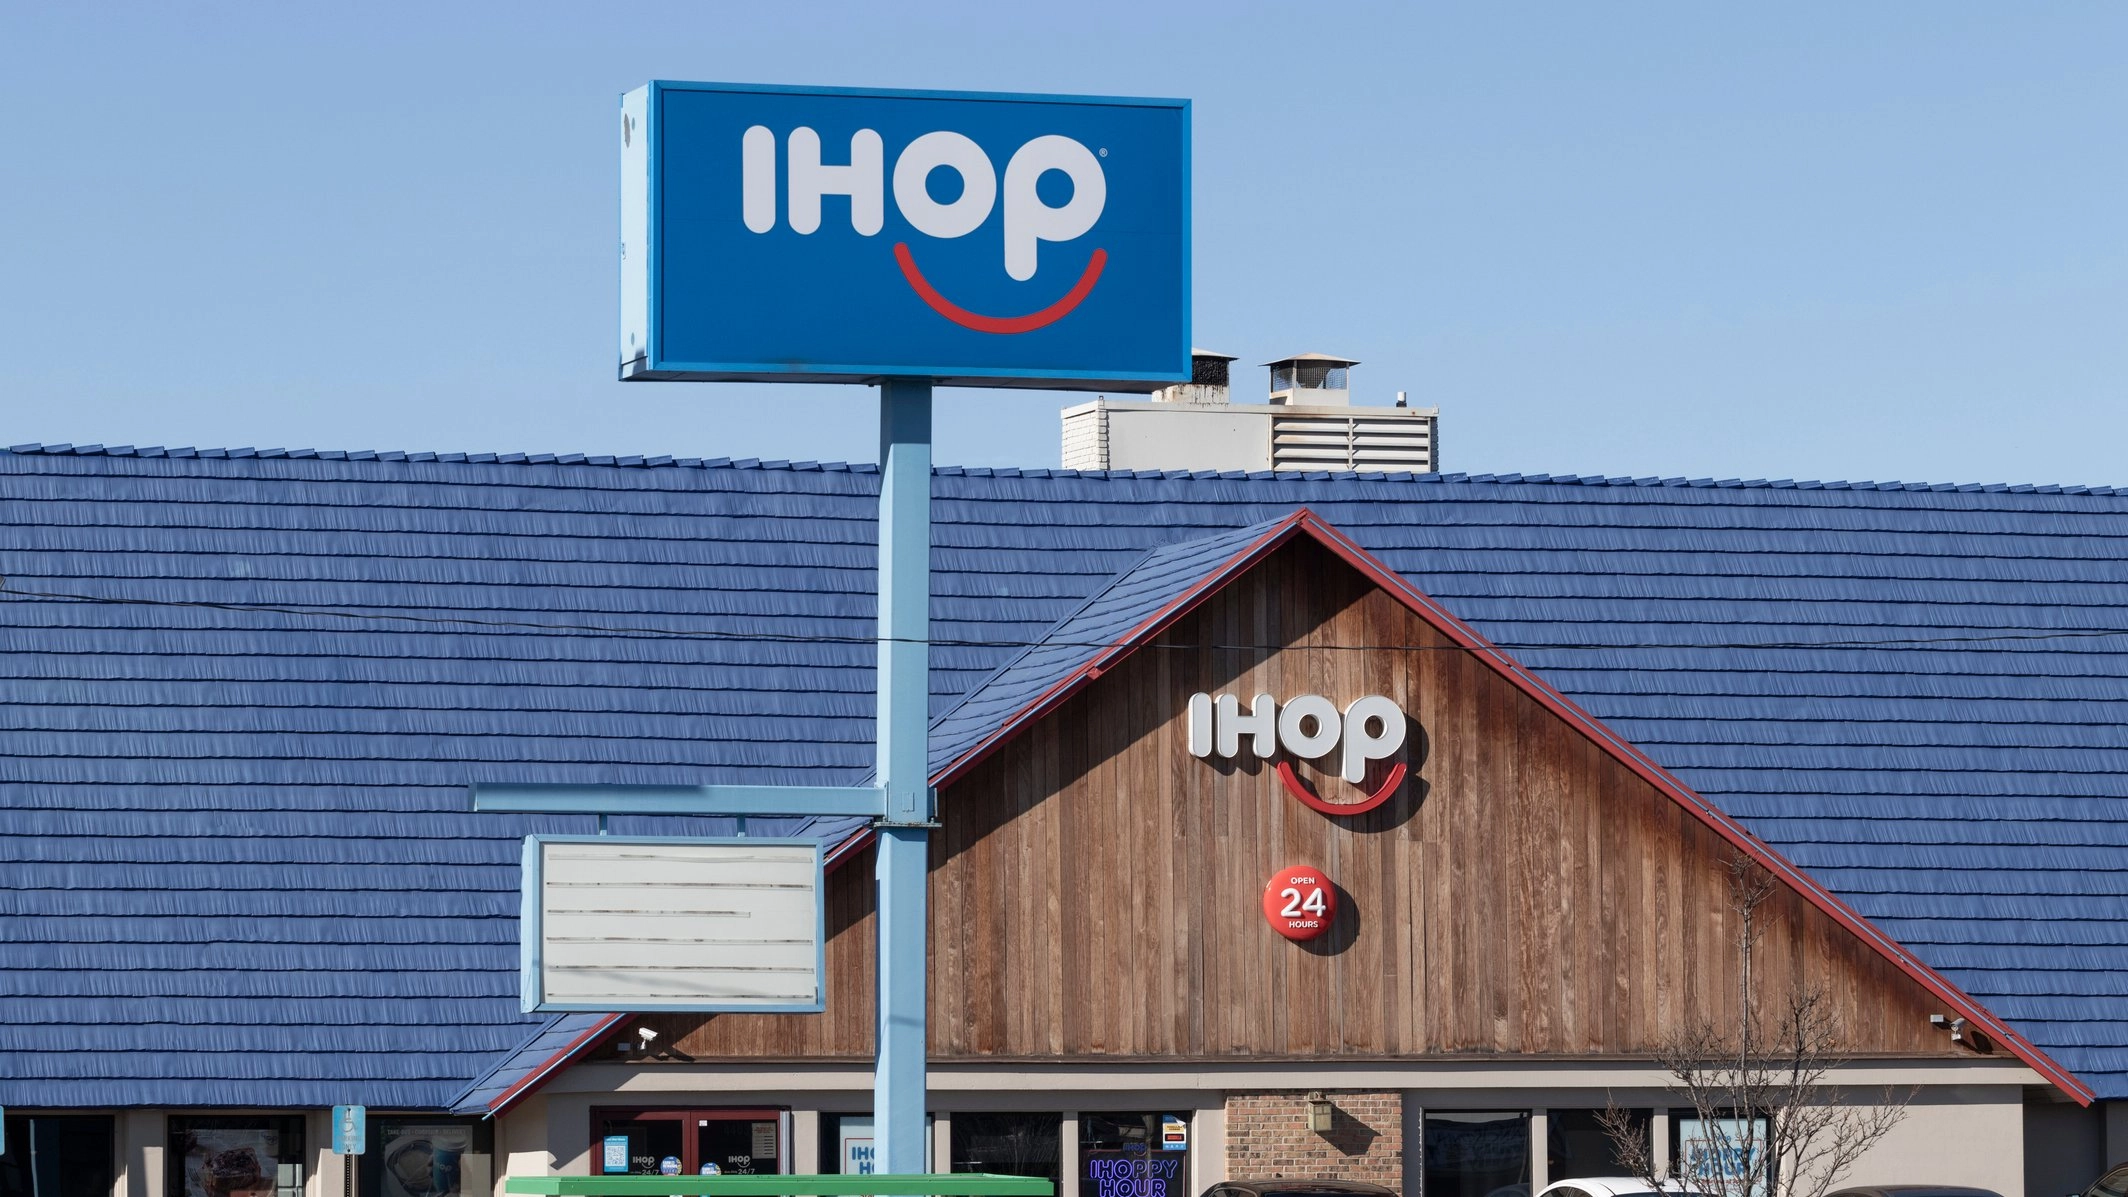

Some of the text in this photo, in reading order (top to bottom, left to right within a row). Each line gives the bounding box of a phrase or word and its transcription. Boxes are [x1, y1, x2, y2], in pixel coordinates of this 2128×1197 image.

[742, 124, 1107, 282] IHOP
[1188, 691, 1406, 784] IHOP
[1290, 876, 1315, 885] OPEN
[1280, 887, 1327, 917] 24
[1288, 920, 1319, 929] HOURS
[632, 1156, 655, 1166] IHOP
[728, 1155, 751, 1165] IHOP
[1090, 1159, 1178, 1179] IHOPPY
[1099, 1178, 1166, 1197] HOUR
